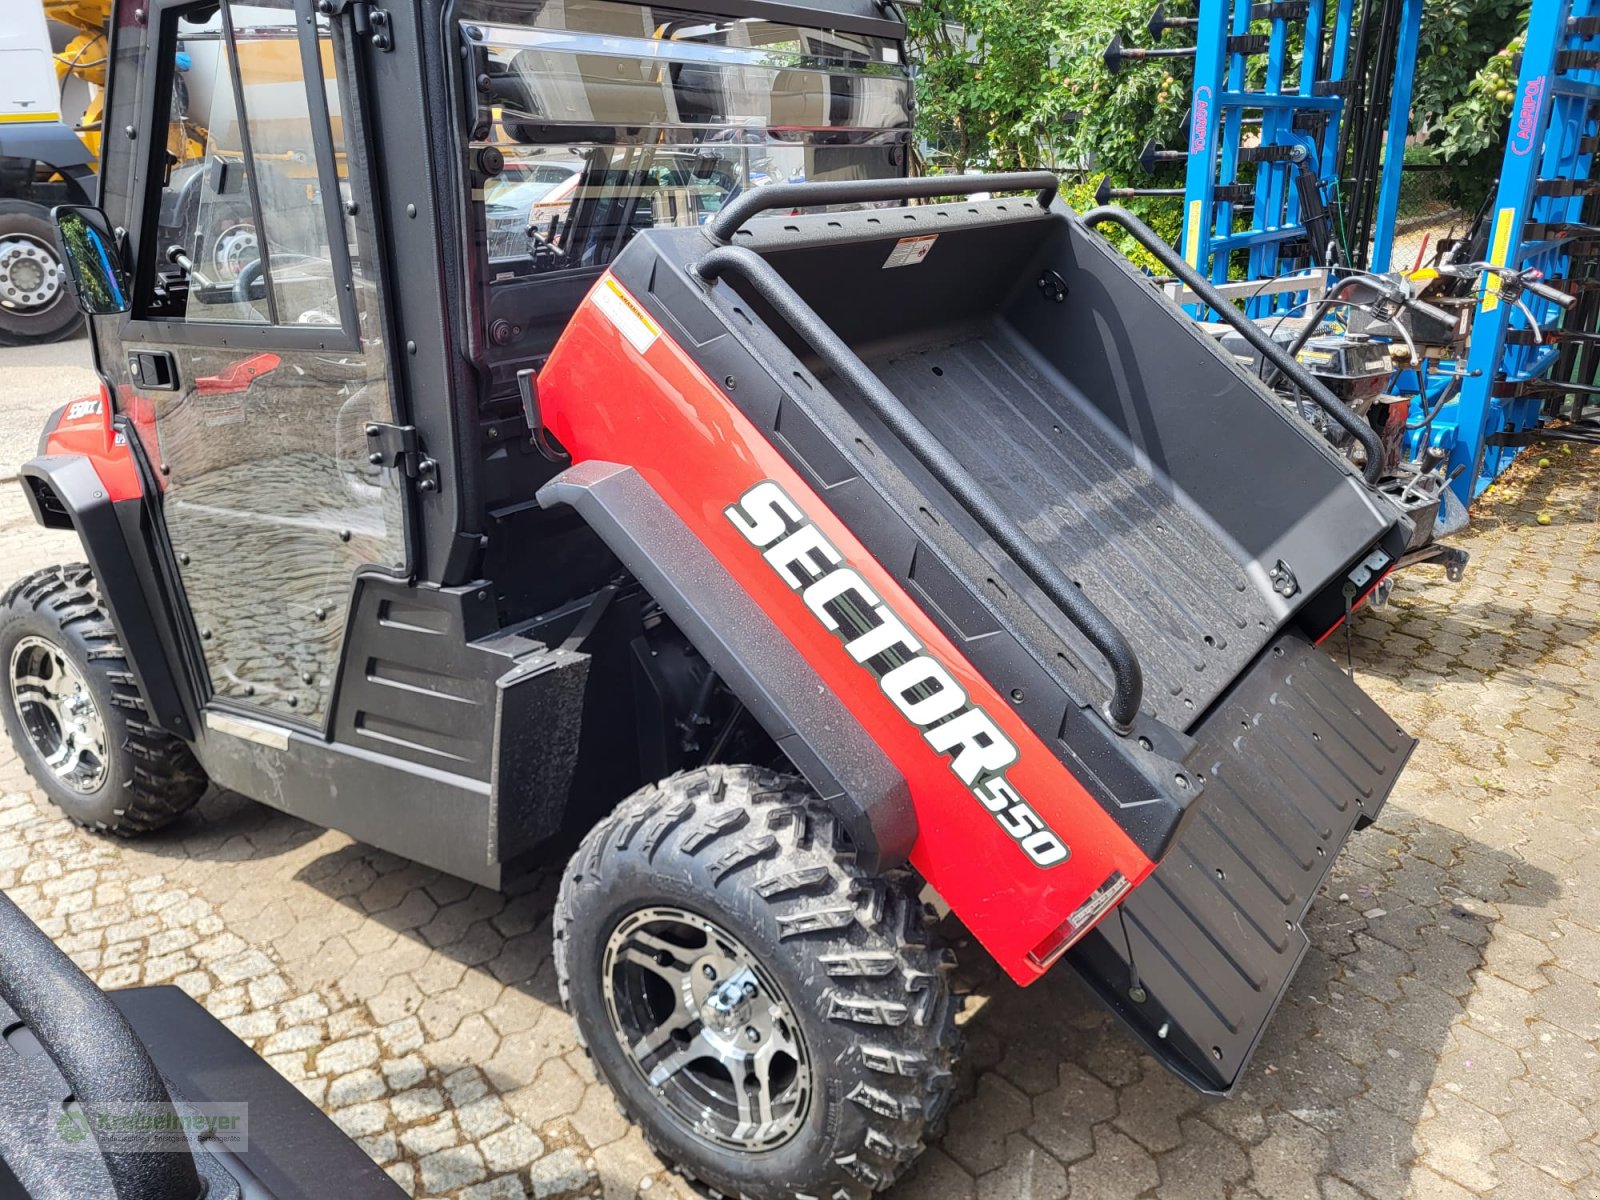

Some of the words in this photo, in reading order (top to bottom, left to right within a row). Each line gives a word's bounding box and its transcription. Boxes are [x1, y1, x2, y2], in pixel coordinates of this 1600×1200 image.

[1191, 100, 1209, 155] AGRIPOL
[1516, 76, 1543, 140] AGRIPOL
[623, 296, 645, 321] WARNING
[724, 481, 1019, 786] SECTOR
[972, 775, 1069, 866] 550
